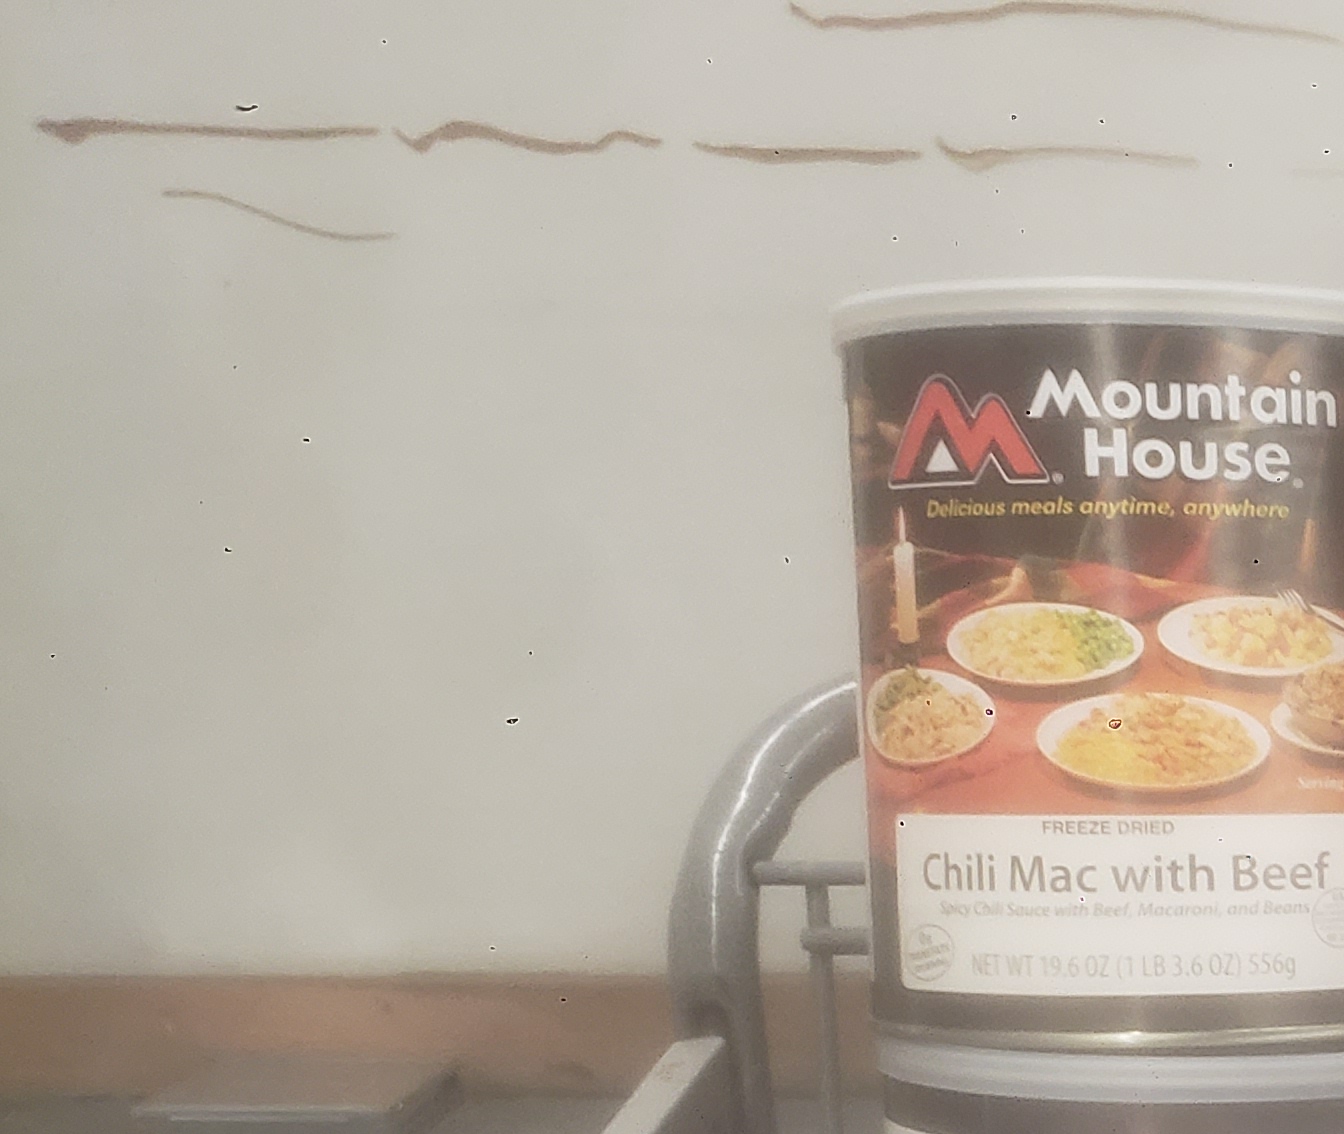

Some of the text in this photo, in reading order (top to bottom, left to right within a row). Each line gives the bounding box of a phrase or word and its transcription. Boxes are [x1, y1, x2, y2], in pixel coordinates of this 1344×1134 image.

[1029, 367, 1338, 429] Mountain
[1083, 427, 1292, 483] House
[926, 496, 1290, 520] Delicious meals anytime, anywhere
[1041, 819, 1176, 835] FREEZE DRIED
[922, 851, 1331, 894] Chili Mac with Beef
[940, 901, 970, 918] Spicy
[974, 901, 1001, 916] Chili
[1006, 902, 1050, 917] Sauce
[1055, 902, 1089, 917] with
[1137, 902, 1222, 918] Macaroni,
[1227, 901, 1259, 916] and
[1262, 901, 1310, 916] Beans
[971, 954, 1000, 977] NET
[1005, 954, 1035, 977] WT
[1040, 955, 1080, 978] 19.6
[1084, 954, 1110, 977] OZ
[1116, 954, 1133, 979] (1
[1142, 954, 1167, 977] LB
[1171, 954, 1203, 977] 3.6
[1208, 953, 1243, 978] OZ)
[1248, 953, 1297, 979] 556g
